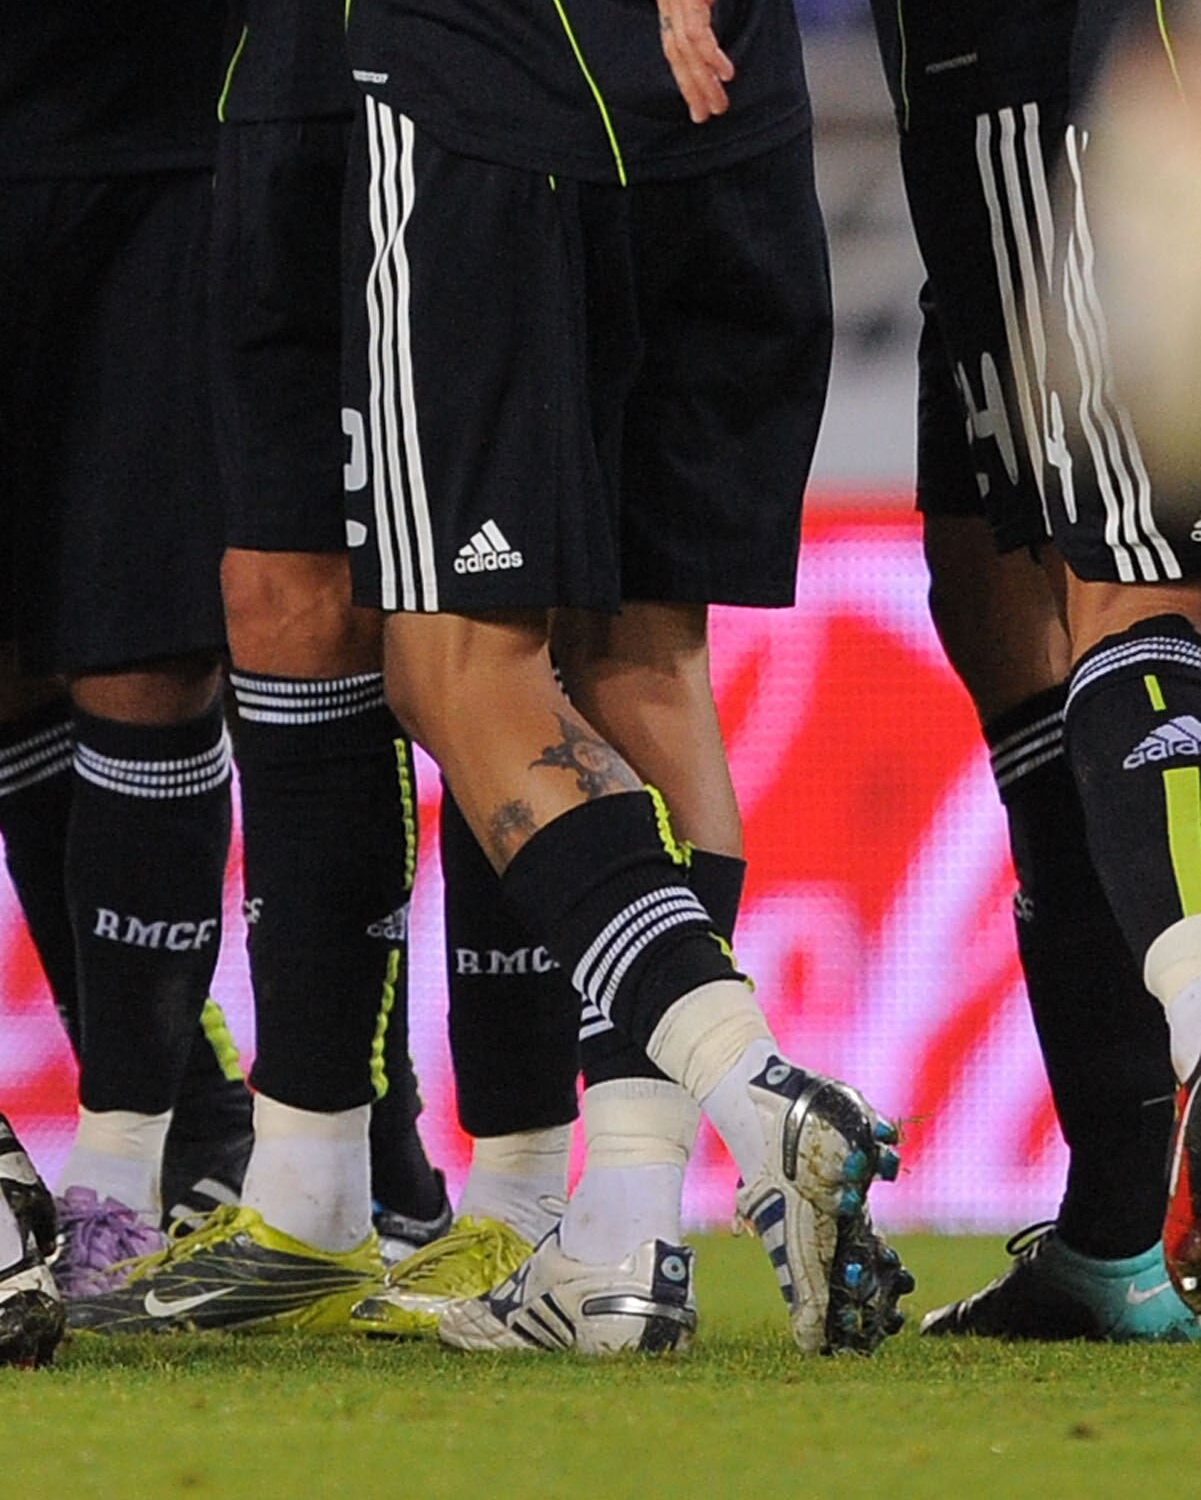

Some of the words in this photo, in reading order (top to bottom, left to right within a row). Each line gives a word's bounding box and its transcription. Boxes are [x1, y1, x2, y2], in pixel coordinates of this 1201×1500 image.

[453, 551, 524, 575] adidas
[94, 907, 217, 952] RMCF
[455, 945, 561, 975] RMC
